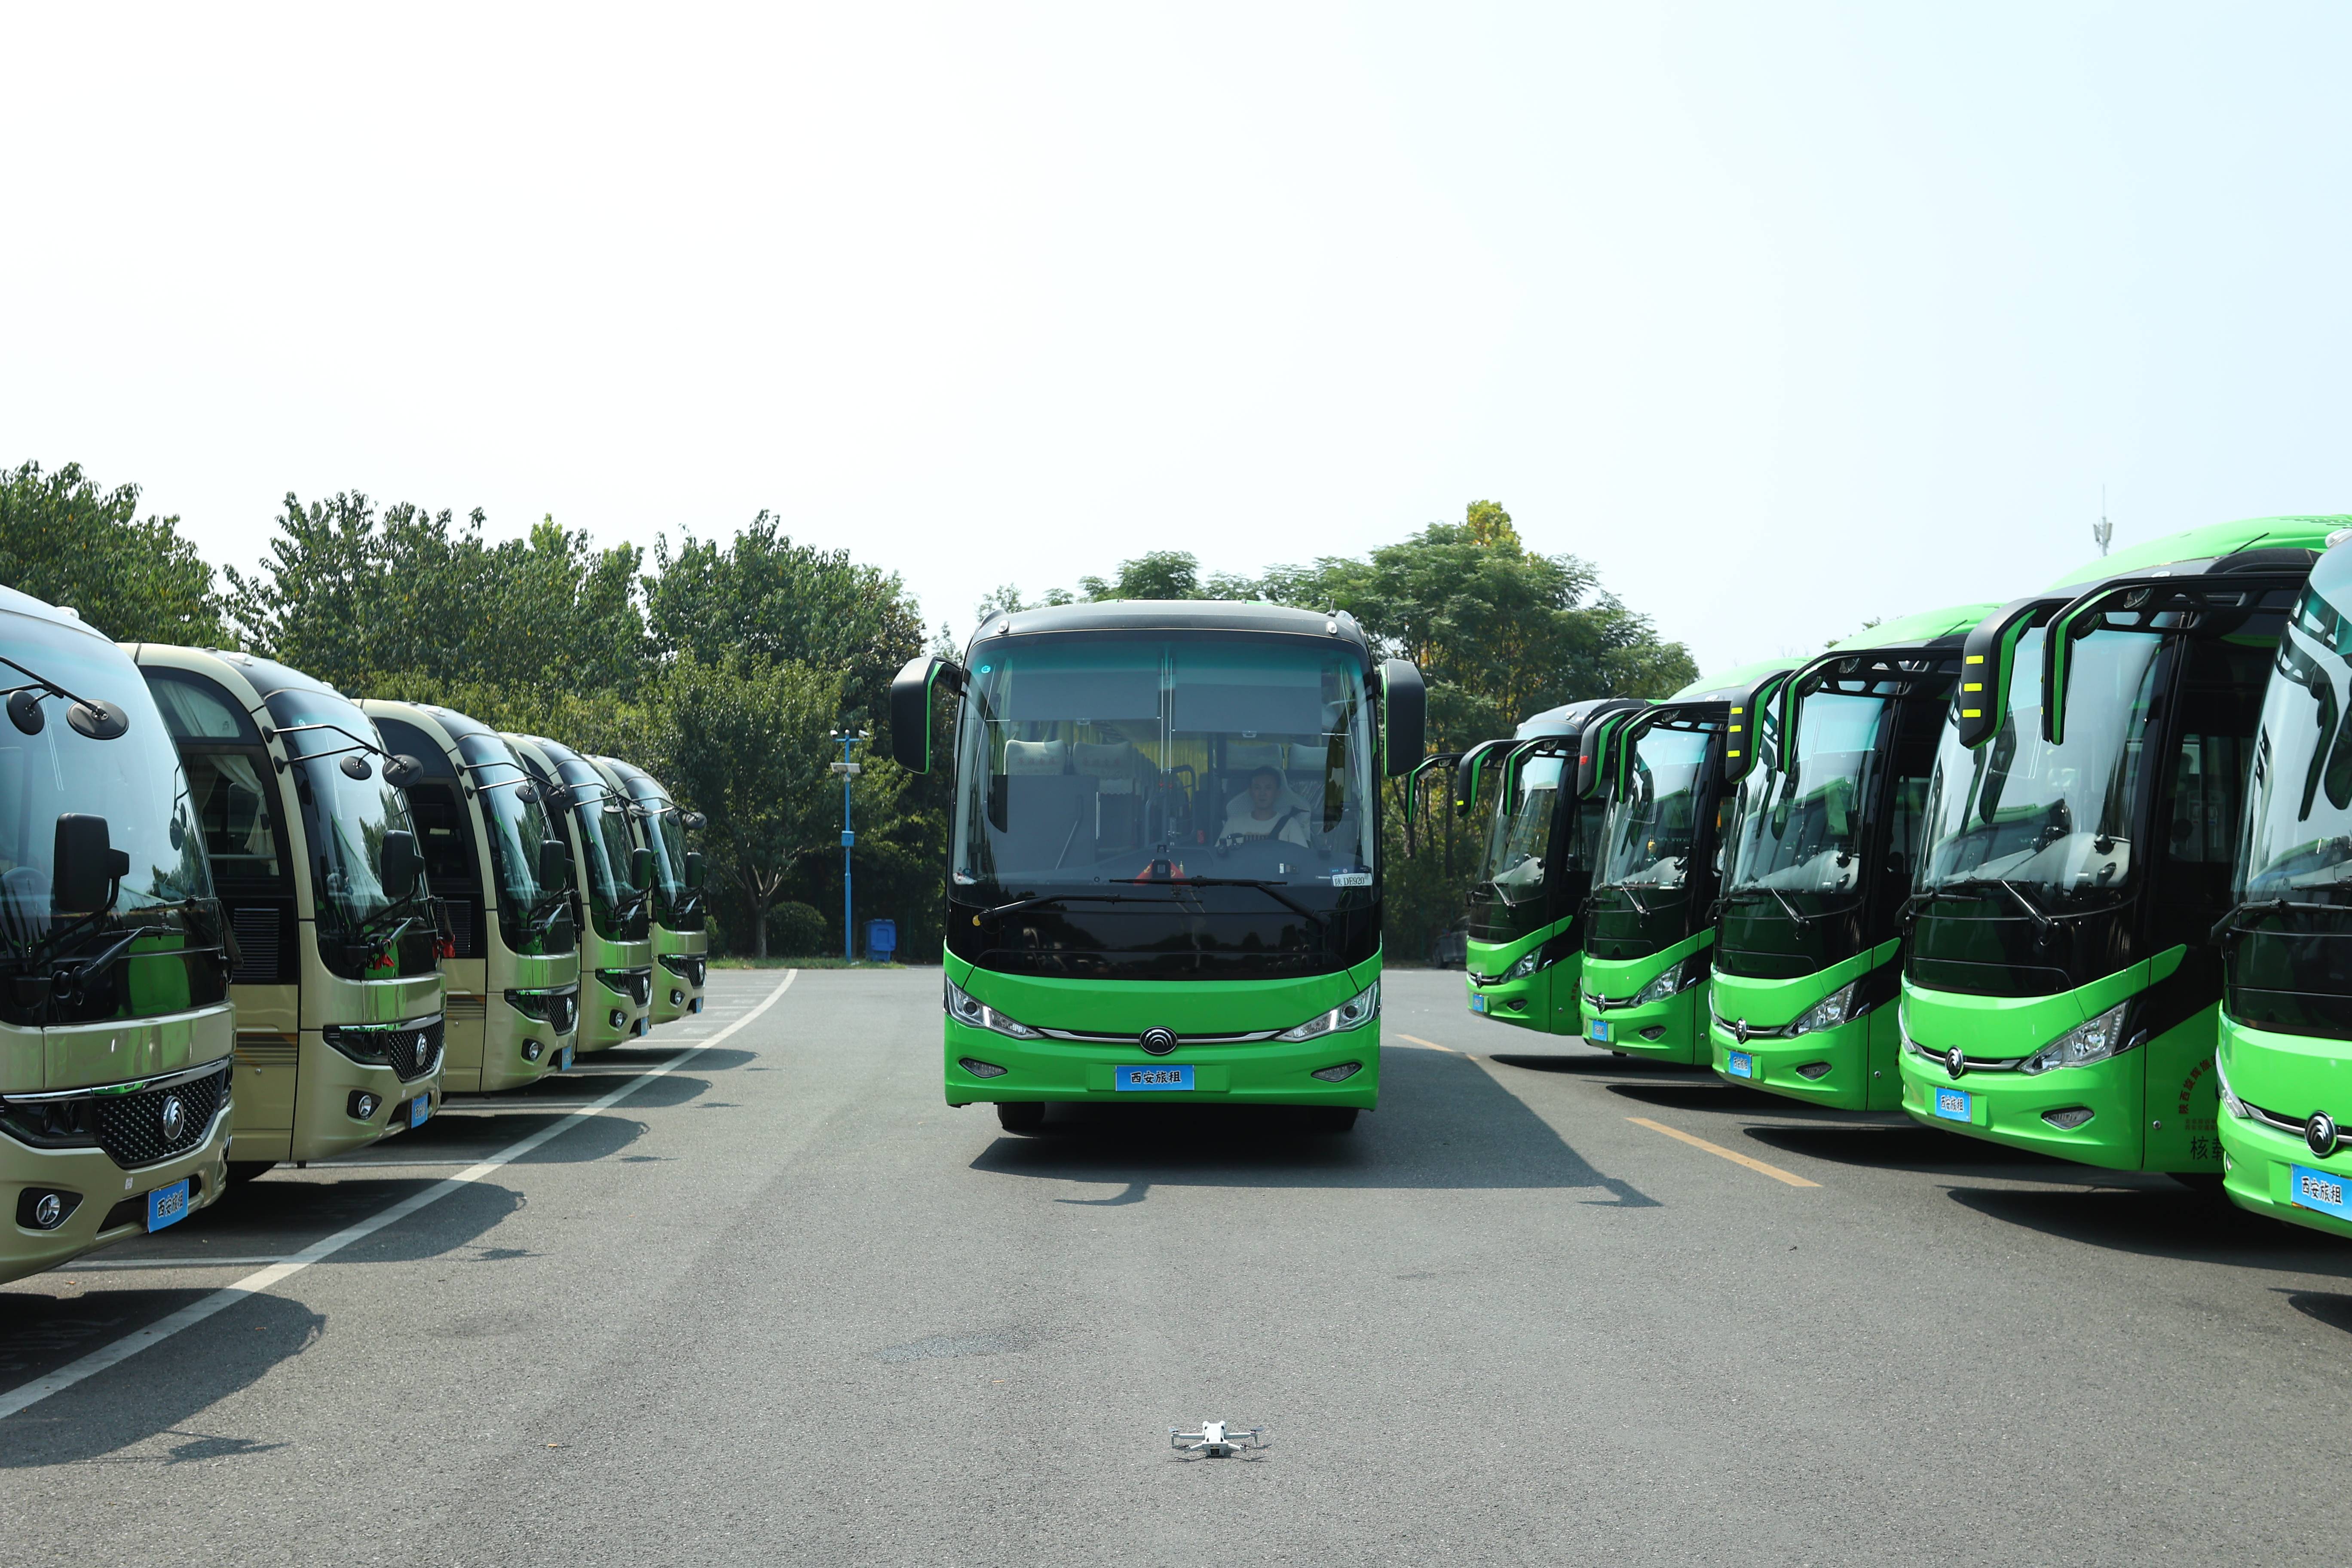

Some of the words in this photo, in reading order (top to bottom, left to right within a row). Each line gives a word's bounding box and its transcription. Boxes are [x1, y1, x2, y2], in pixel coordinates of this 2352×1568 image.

[1131, 1070, 1182, 1084] 西安旅租
[1940, 1095, 1964, 1113] 西安旅租
[2301, 1176, 2343, 1206] 西安旅租
[157, 1189, 183, 1218] 西安旅租
